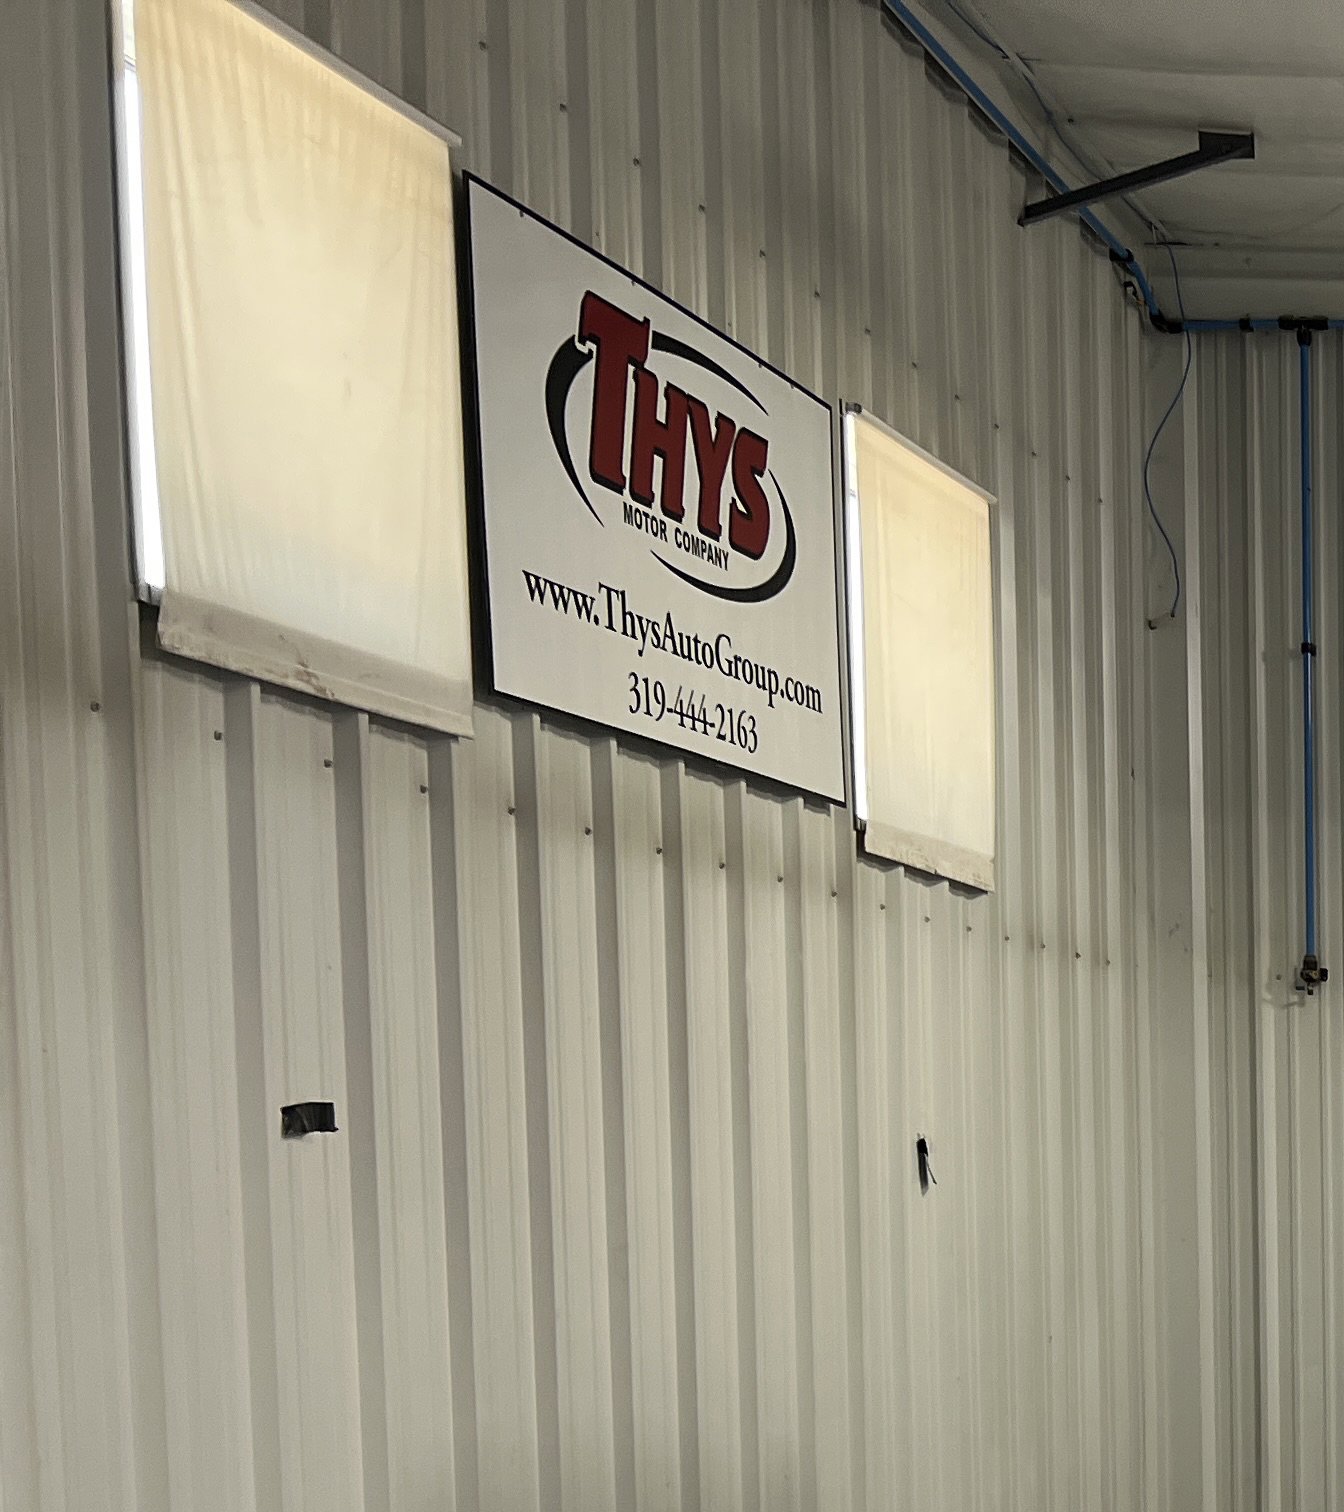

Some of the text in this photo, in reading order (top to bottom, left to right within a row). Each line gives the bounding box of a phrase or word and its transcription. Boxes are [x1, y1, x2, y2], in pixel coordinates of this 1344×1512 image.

[579, 290, 771, 562] THYS
[623, 502, 729, 571] MOTOR COMPANY
[523, 569, 823, 714] www.ThysAutoGroup.com
[628, 672, 758, 754] 319-444-2163
